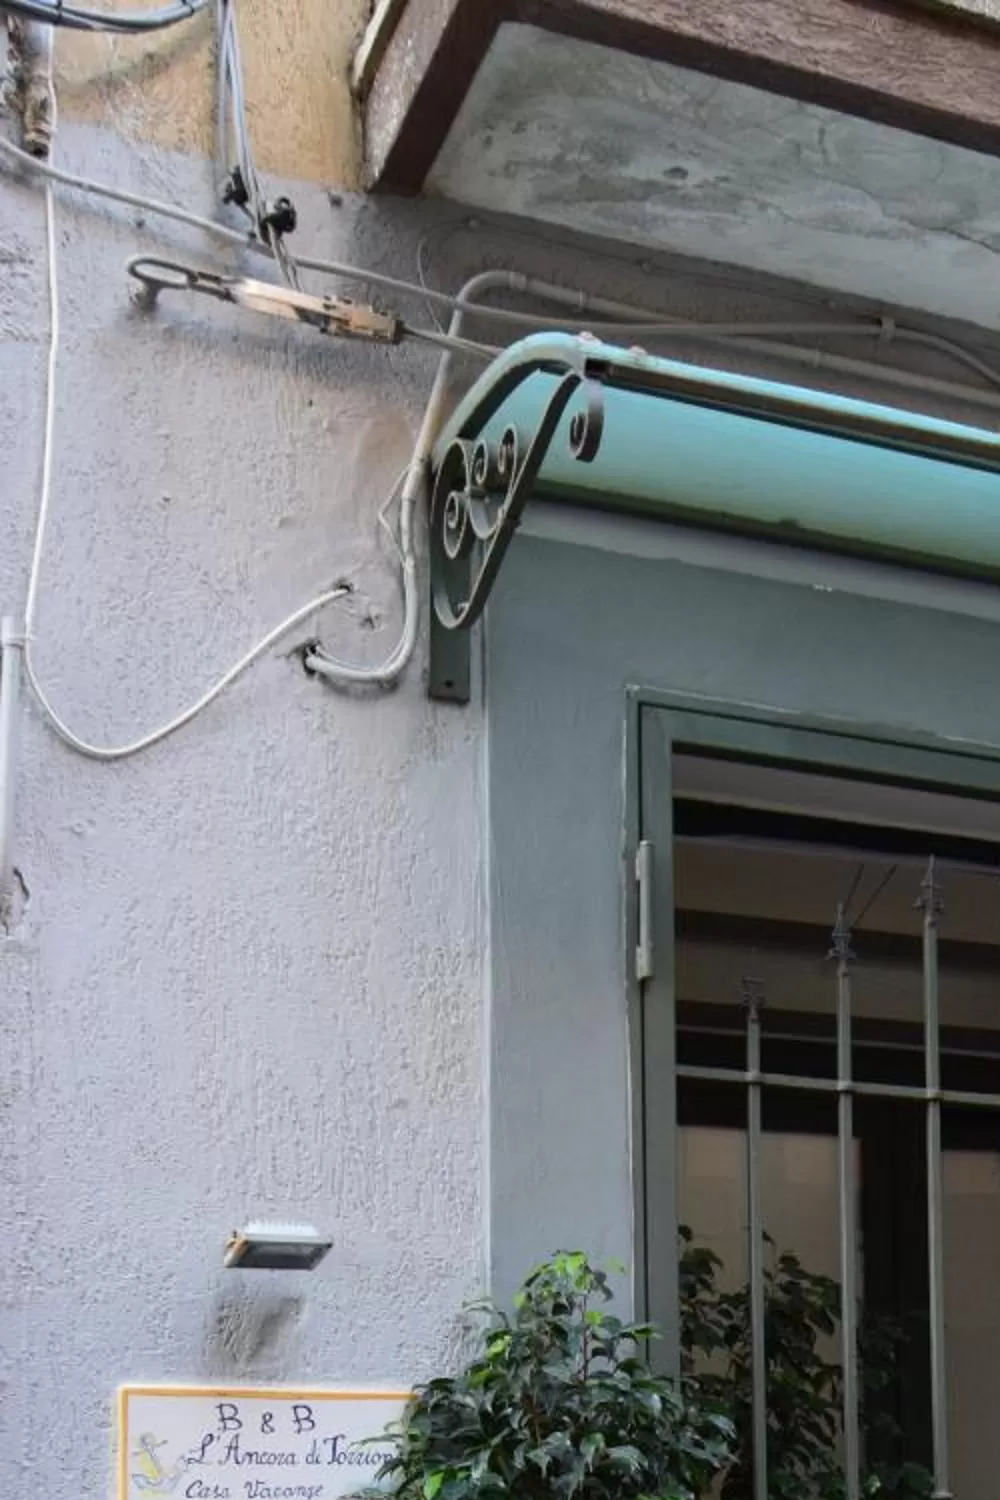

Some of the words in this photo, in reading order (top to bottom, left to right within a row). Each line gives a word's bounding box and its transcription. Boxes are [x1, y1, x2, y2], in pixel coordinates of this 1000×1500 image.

[215, 1403, 243, 1432] B
[261, 1412, 275, 1434] &
[292, 1404, 316, 1434] B
[186, 1433, 297, 1466] L'Ancora
[306, 1439, 321, 1465] di
[323, 1434, 396, 1466] Torrion
[185, 1479, 230, 1499] Casa
